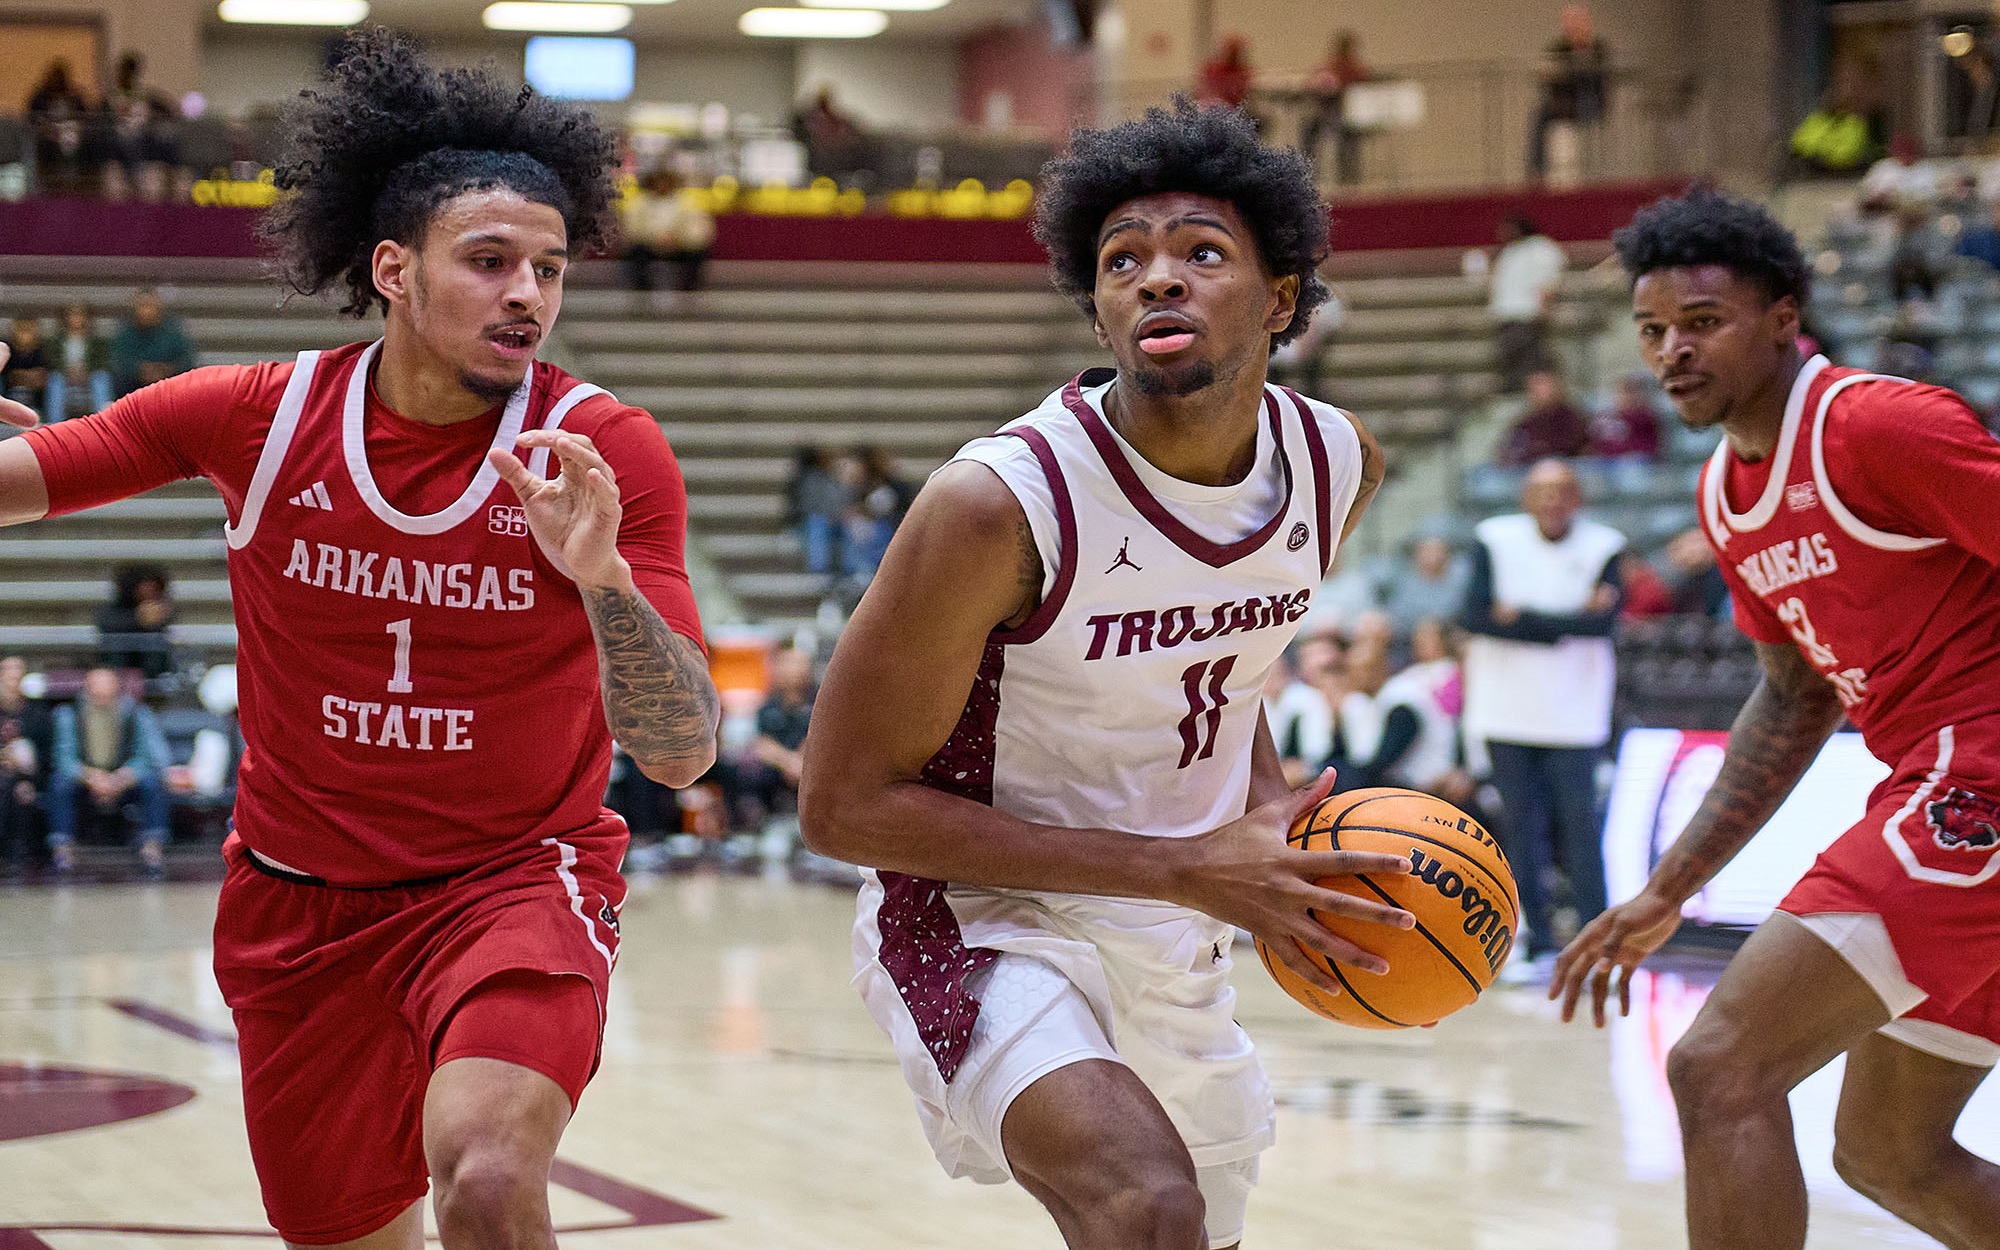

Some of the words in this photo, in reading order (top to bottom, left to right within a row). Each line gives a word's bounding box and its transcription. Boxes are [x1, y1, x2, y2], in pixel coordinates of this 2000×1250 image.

[488, 505, 528, 537] SB
[283, 538, 535, 611] ARKANSAS
[385, 618, 414, 693] 1
[1084, 588, 1311, 661] TROJANS
[322, 694, 474, 751] STATE
[1177, 654, 1239, 769] 11
[1409, 846, 1513, 978] Wilson
